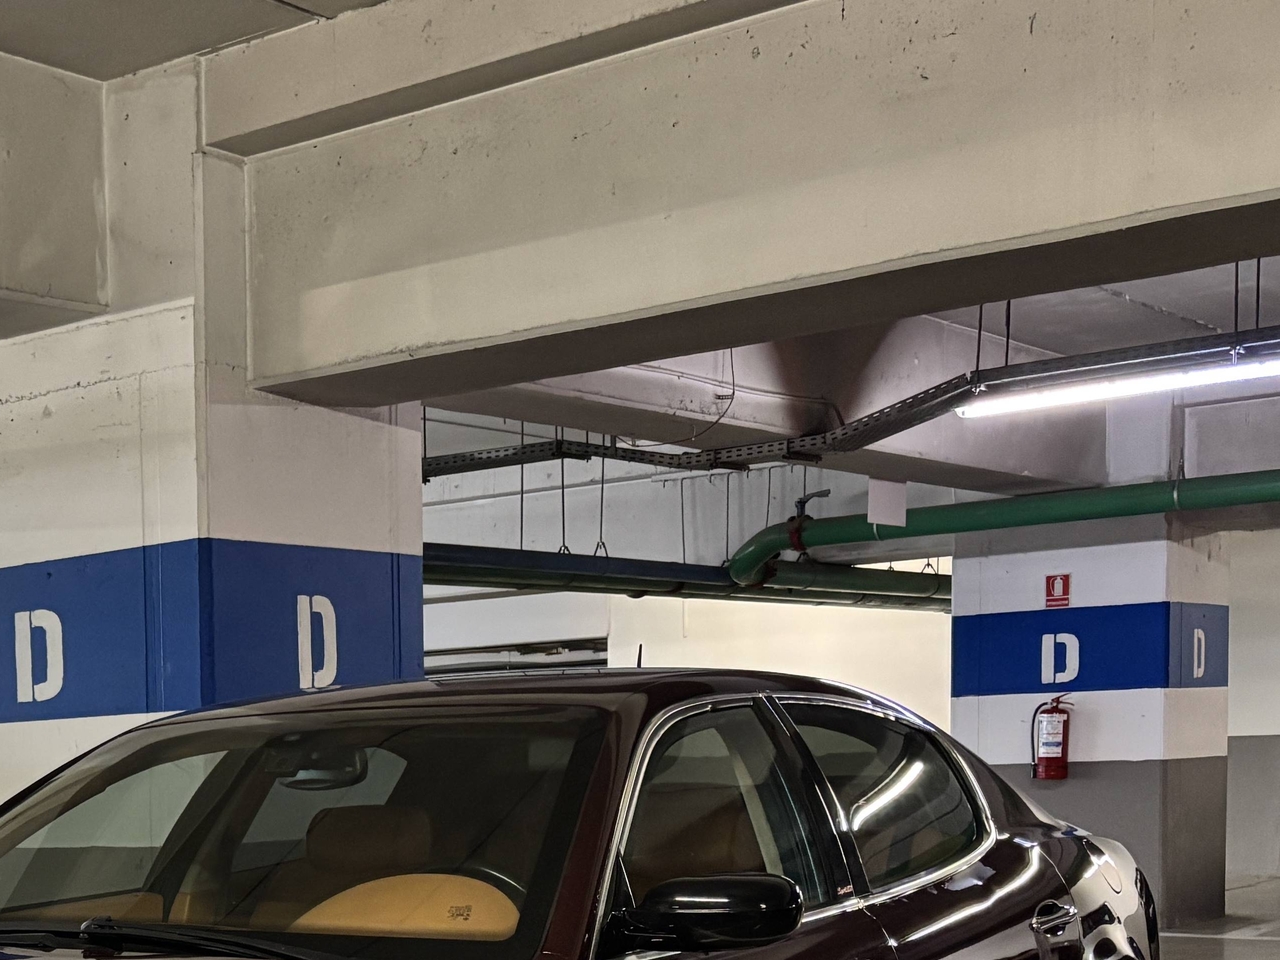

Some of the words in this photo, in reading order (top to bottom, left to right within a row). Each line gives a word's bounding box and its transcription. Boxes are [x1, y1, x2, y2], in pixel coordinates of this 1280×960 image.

[14, 608, 64, 703] D
[296, 594, 338, 689] D
[1041, 633, 1080, 684] D
[1193, 628, 1206, 679] D
